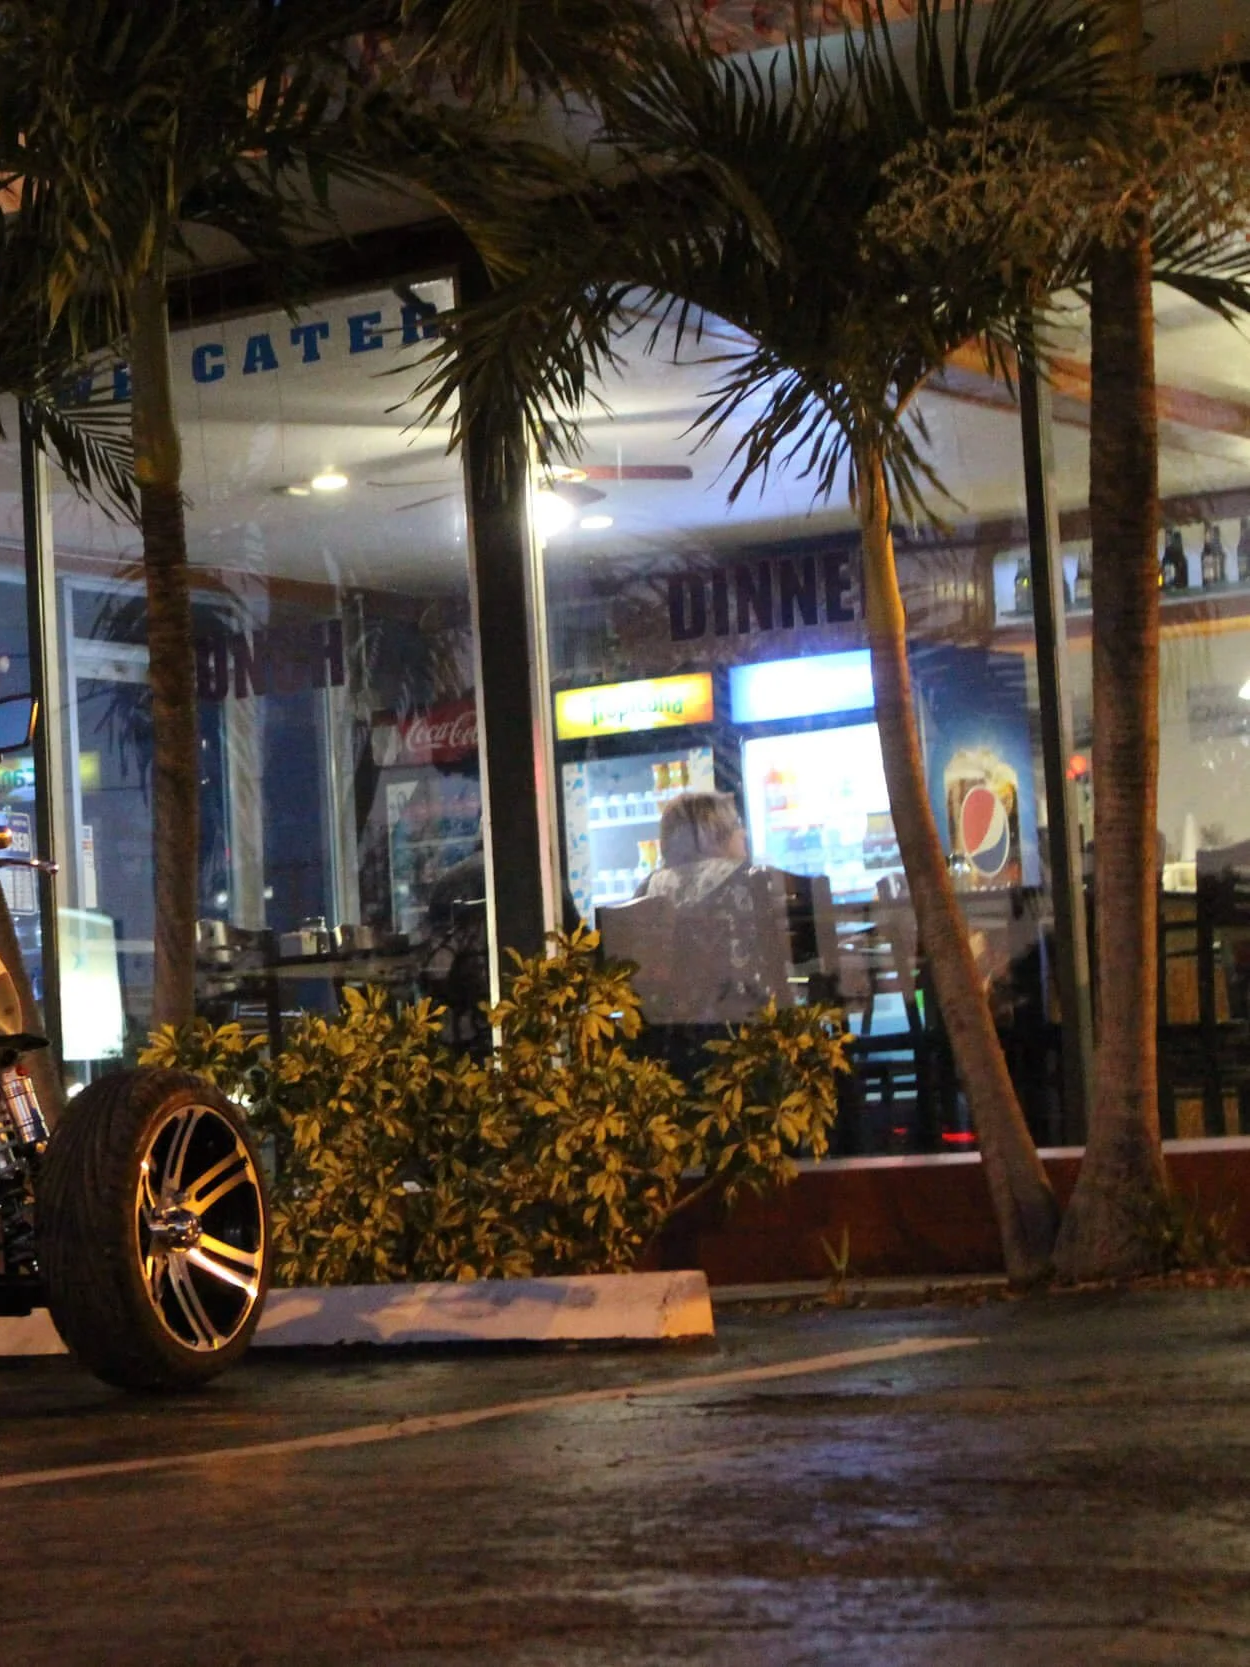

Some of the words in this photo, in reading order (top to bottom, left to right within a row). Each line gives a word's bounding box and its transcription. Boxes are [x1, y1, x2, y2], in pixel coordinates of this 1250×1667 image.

[191, 301, 442, 385] CATER
[668, 550, 865, 641] DINNE
[406, 711, 479, 751] Coca-Col
[590, 694, 684, 727] Tropicana
